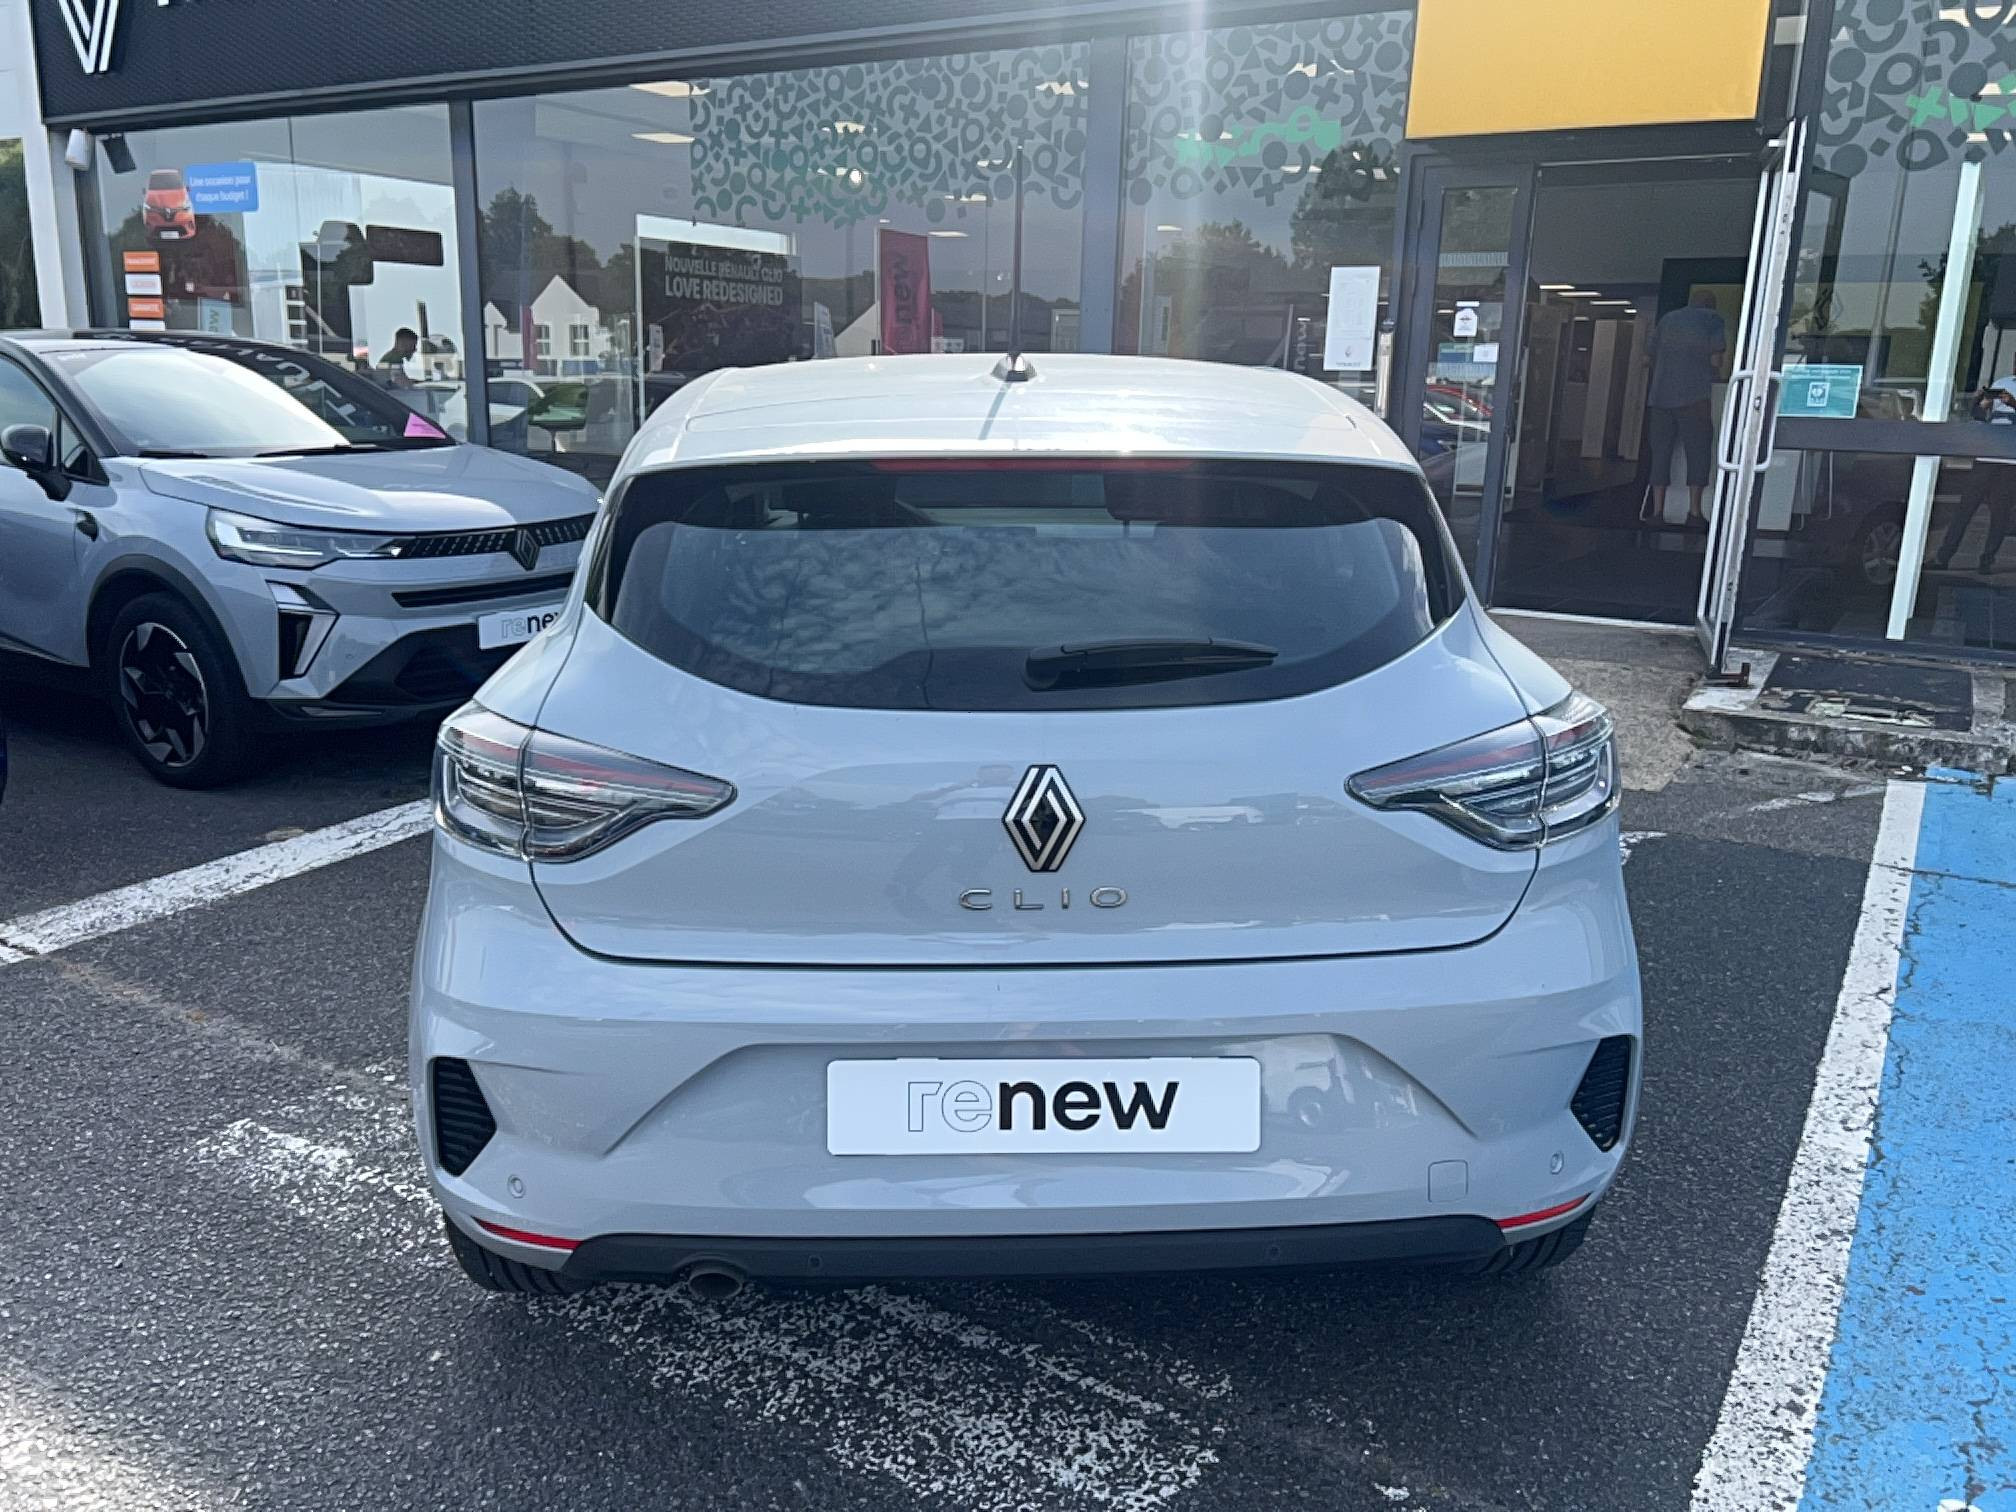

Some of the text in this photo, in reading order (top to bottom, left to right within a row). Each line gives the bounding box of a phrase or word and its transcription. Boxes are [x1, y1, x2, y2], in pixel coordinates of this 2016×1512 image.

[664, 255, 717, 276] NOUVELLE
[664, 274, 783, 306] LOVE REDESIGNED
[501, 612, 558, 639] rene
[959, 886, 1128, 911] CLIO
[907, 1079, 1180, 1133] renew
